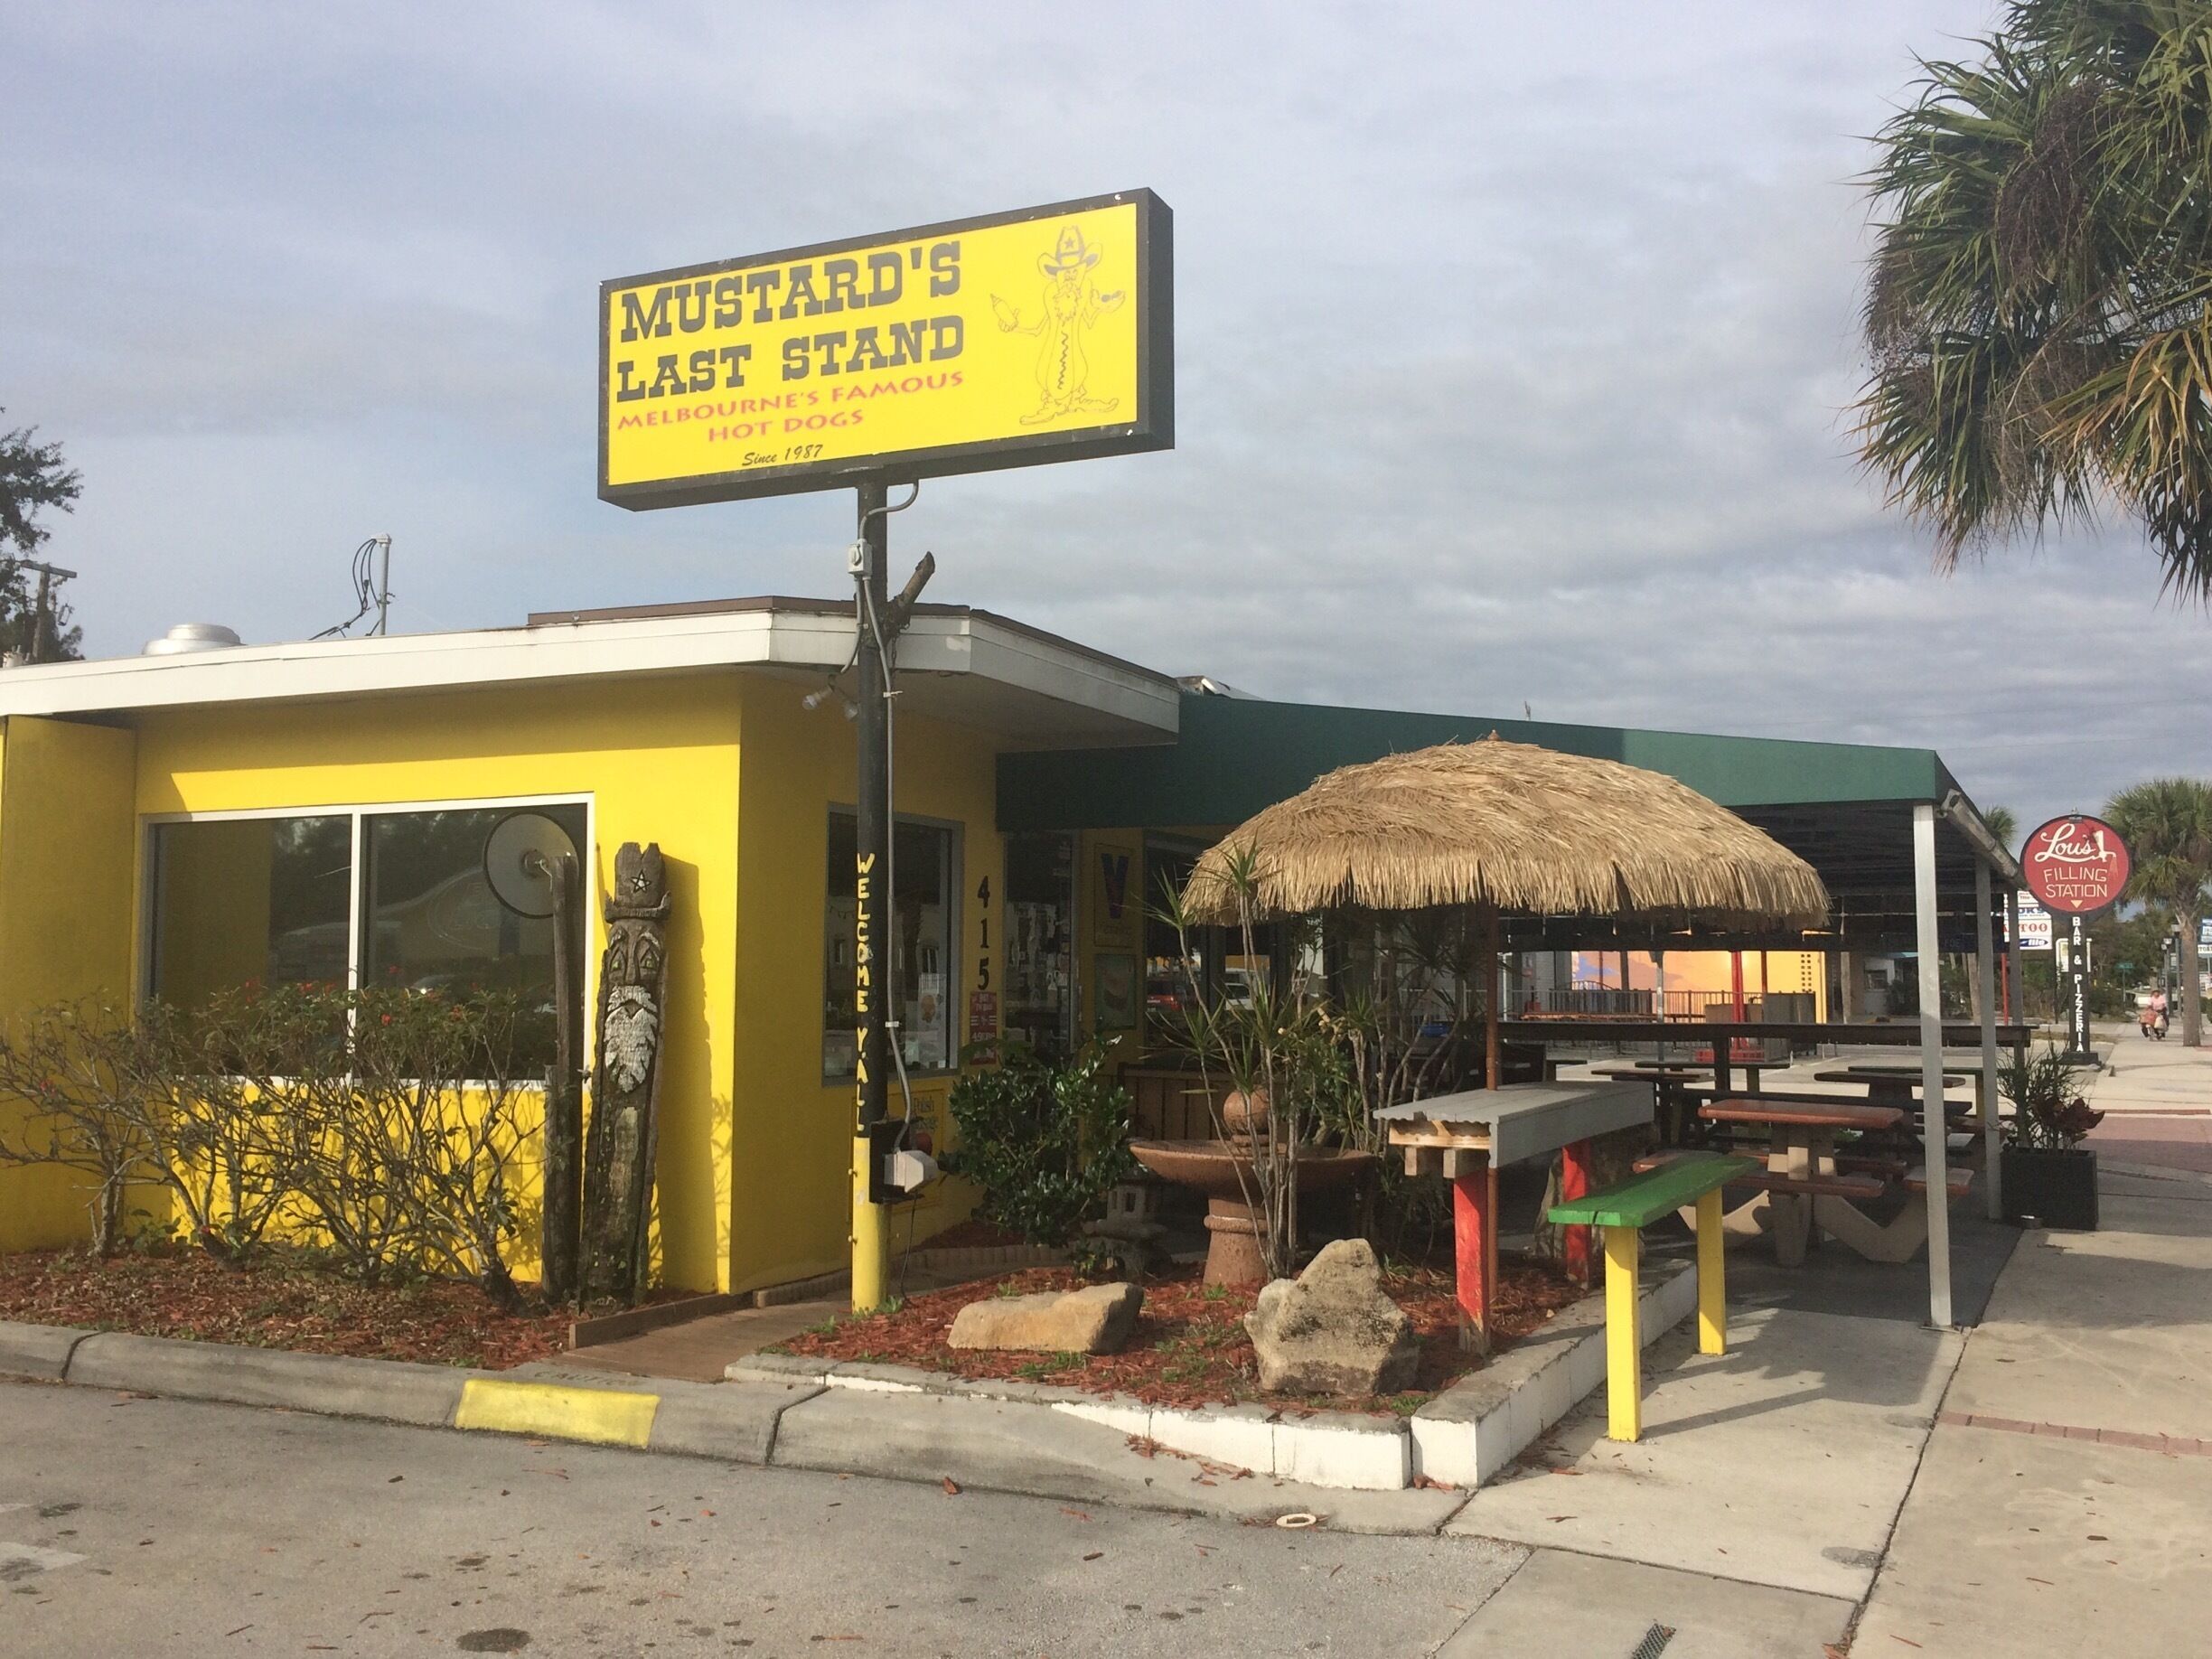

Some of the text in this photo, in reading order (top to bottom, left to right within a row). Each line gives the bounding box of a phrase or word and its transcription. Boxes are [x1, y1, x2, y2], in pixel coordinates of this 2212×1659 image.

[621, 240, 961, 342] MUSTARD'S
[617, 314, 964, 403] LAST STAND
[617, 370, 964, 431] MELBOURNE'S FAMOUS
[708, 408, 864, 443] HOT DOGS
[741, 444, 824, 467] Since 1987
[2043, 866, 2108, 883] FILLING
[2045, 884, 2108, 899] STATION
[857, 852, 876, 1013] WELCOME
[977, 875, 990, 991] 415
[2072, 916, 2084, 1053] BAR & PIZZERIA
